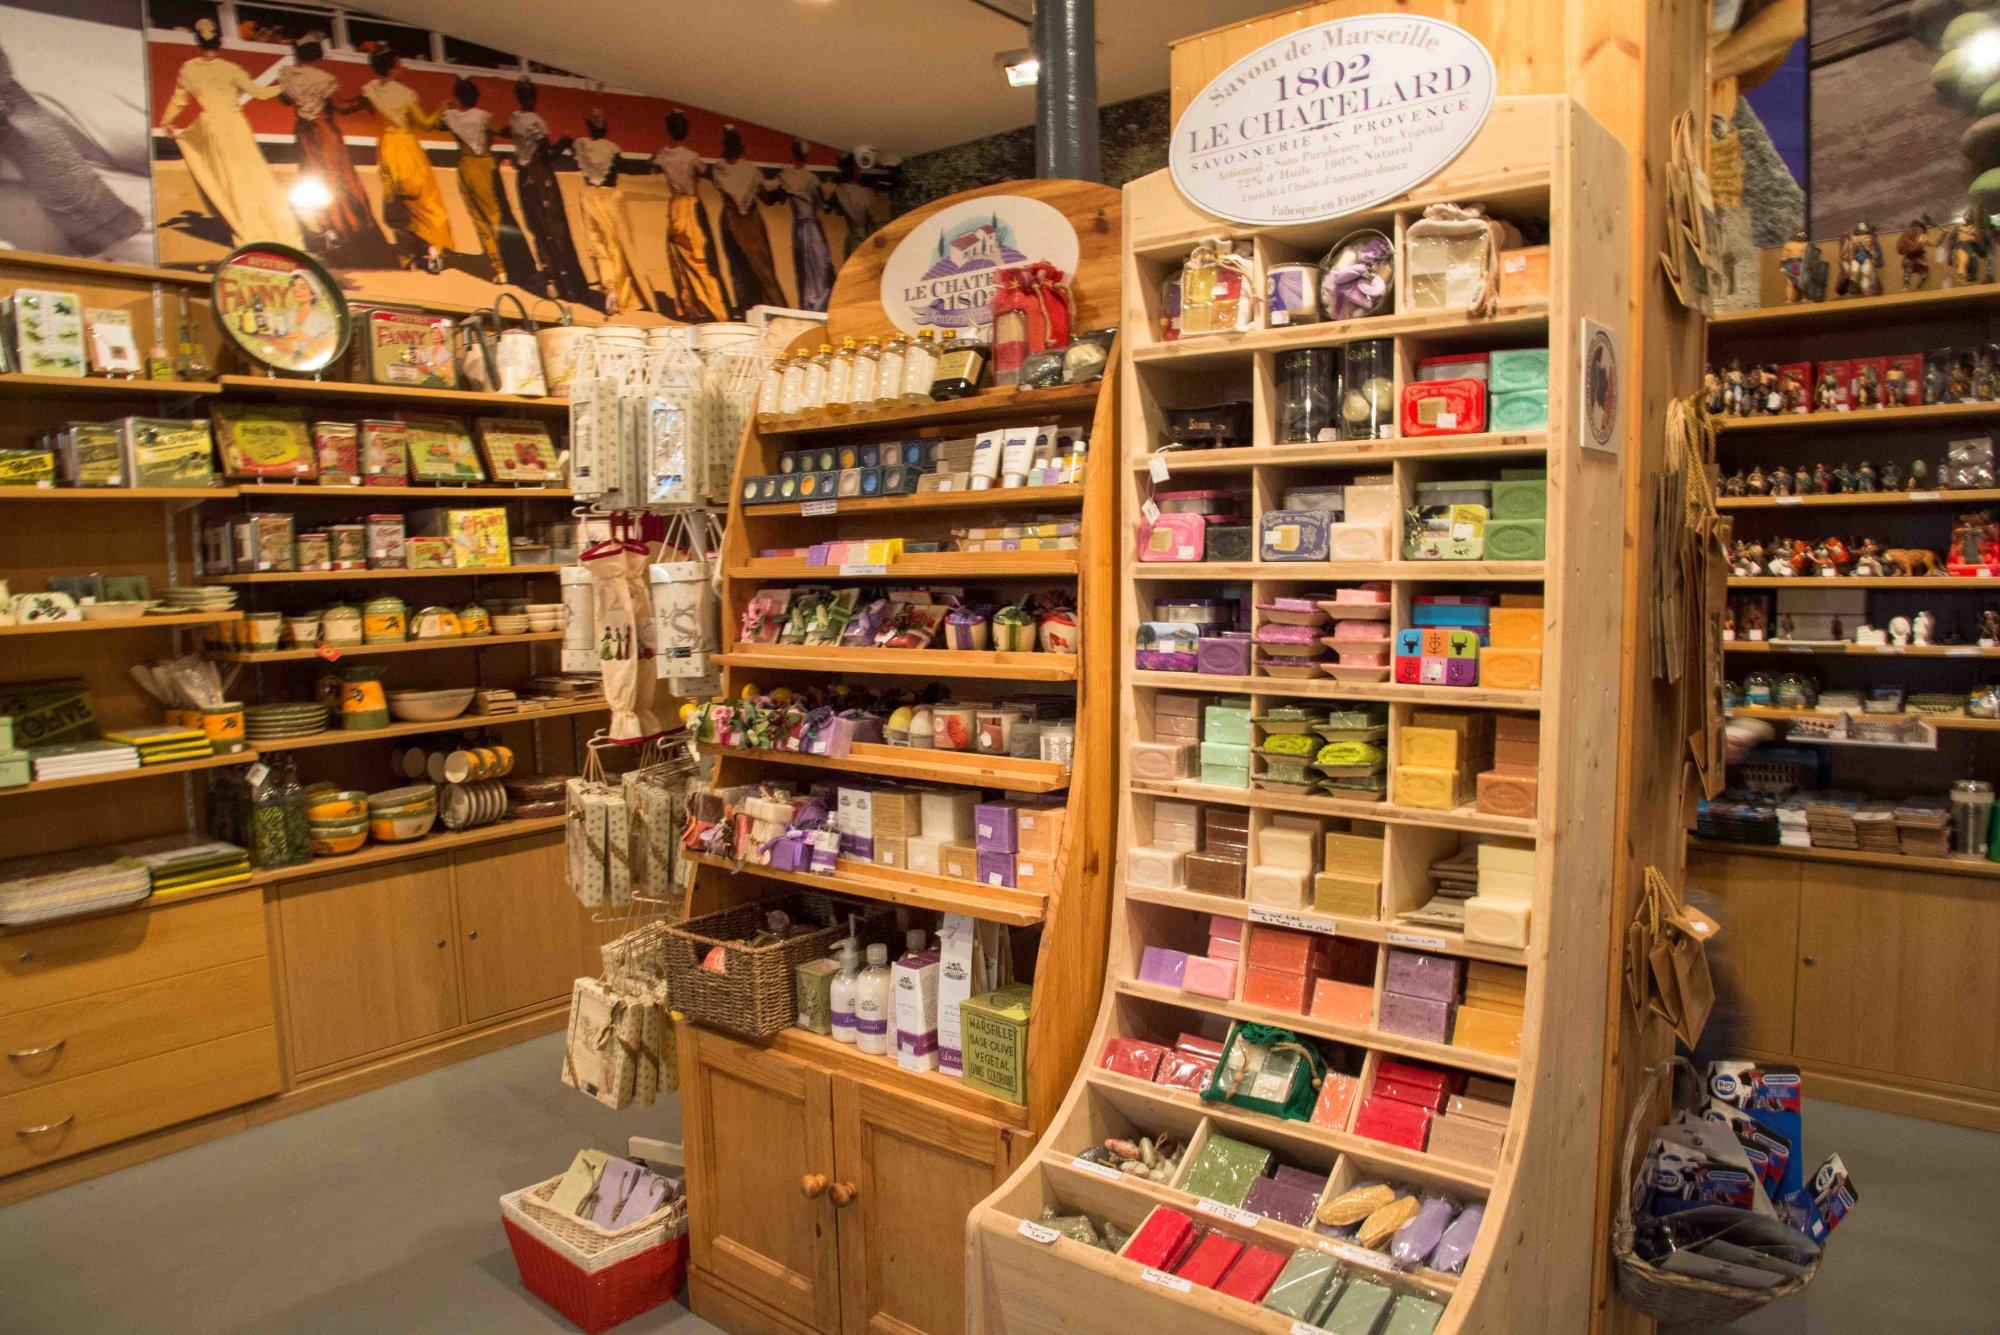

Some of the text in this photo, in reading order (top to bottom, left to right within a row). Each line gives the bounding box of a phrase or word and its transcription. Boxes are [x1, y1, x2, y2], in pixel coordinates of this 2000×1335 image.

[1208, 23, 1441, 108] Savon de Marseille
[1273, 53, 1372, 103] 1802
[1189, 64, 1472, 154] LE CHATELARD
[1190, 99, 1469, 173] SAVONNERIE EN PROVENCE
[1218, 163, 1264, 181] Artisanal
[1274, 157, 1299, 167] Sans
[1373, 134, 1394, 146] Pur
[1323, 154, 1360, 170] 100%
[1365, 143, 1413, 160] Naturel
[1374, 162, 1409, 176] douce
[1321, 200, 1335, 209] en
[1338, 188, 1376, 206] France
[217, 275, 288, 314] FANNY
[903, 271, 993, 302] LE CHATE
[968, 1017, 1014, 1041] MARSEILLE
[969, 1032, 1014, 1057] BASE OLIVE
[974, 1049, 1010, 1071] VEGETAL
